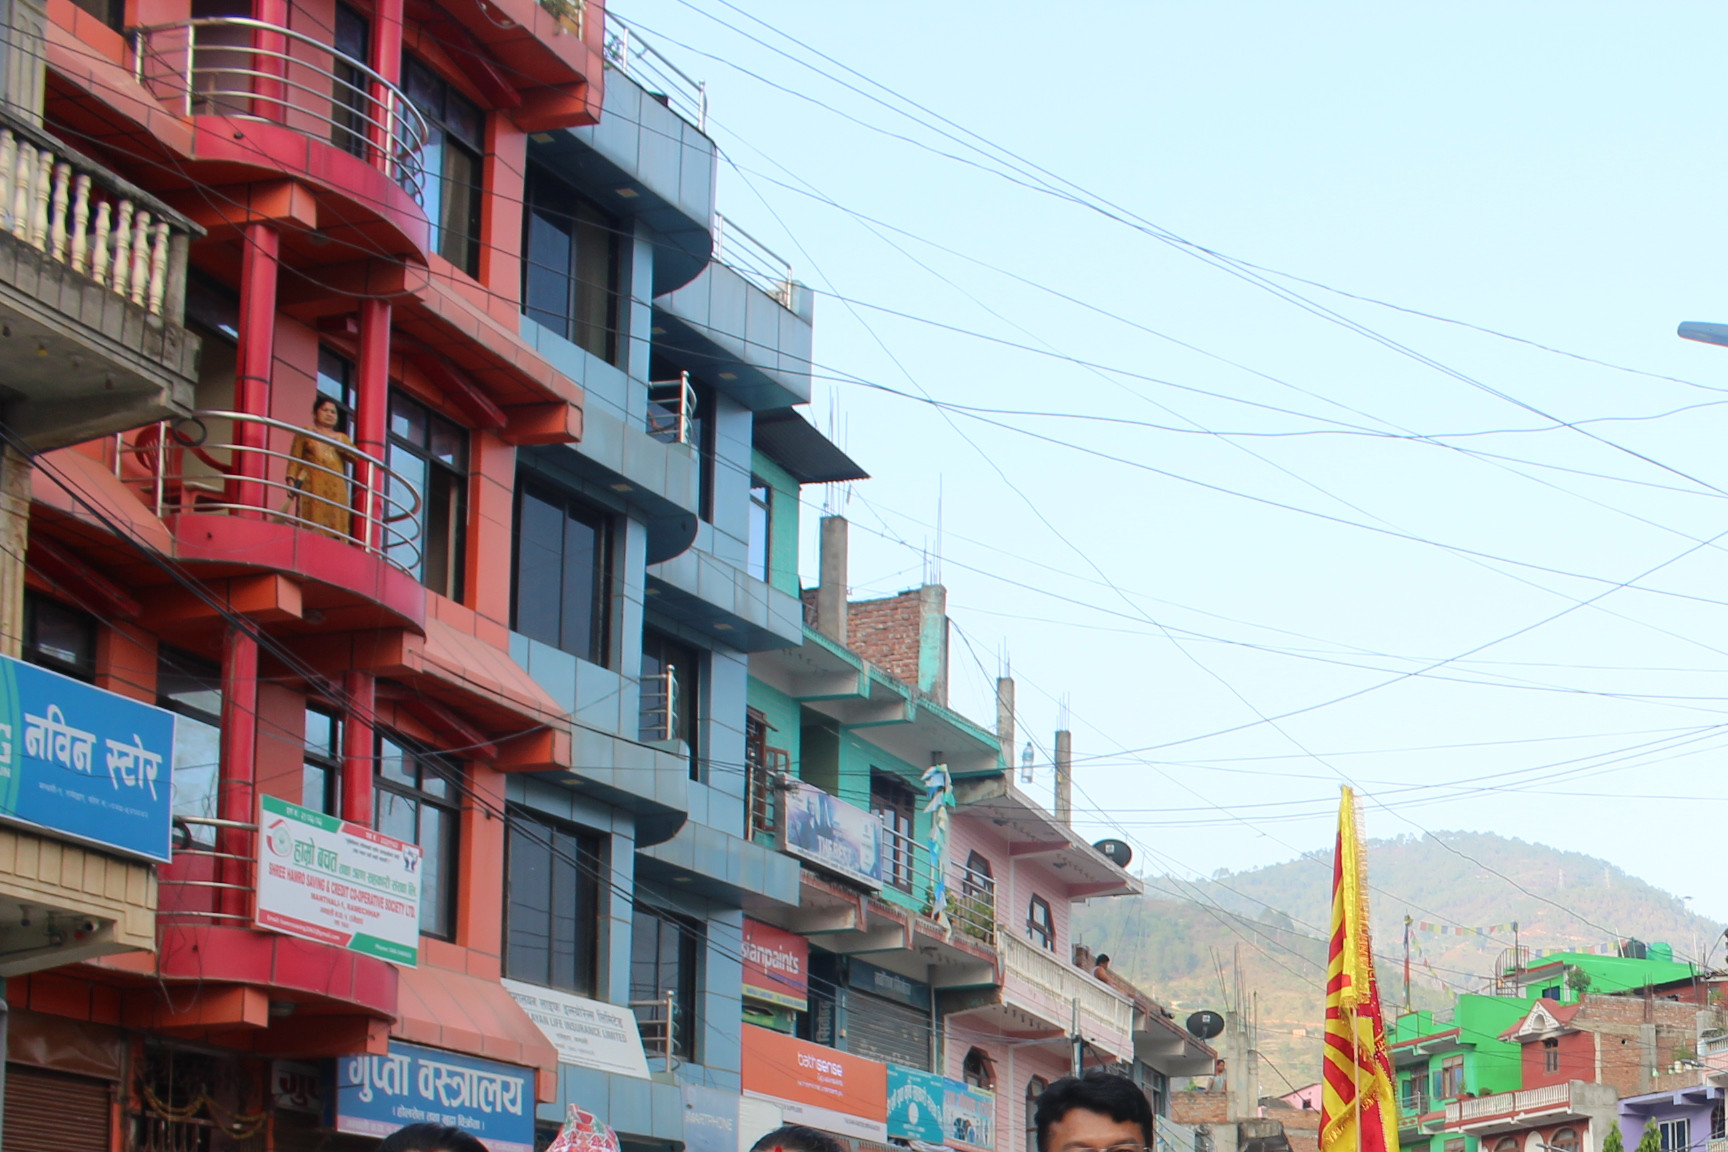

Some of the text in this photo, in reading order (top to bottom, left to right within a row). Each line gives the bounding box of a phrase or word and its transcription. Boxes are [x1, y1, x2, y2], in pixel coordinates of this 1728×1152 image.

[24, 703, 97, 775] नविन
[105, 733, 163, 802] स्टोर
[293, 837, 316, 866] हाम्रो
[317, 847, 339, 873] बचत
[269, 862, 286, 880] SHREE
[287, 868, 306, 885] HAMRO
[306, 873, 326, 891] SAVING
[331, 881, 349, 899] CREDIT
[385, 896, 405, 915] SOCIETY
[741, 934, 800, 977] sianpaints
[549, 1018, 564, 1030] LIFE
[564, 1020, 601, 1038] INSURANCE
[602, 1029, 628, 1044] LIMITED
[348, 1053, 525, 1116] गुप्ता वस्त्रालय
